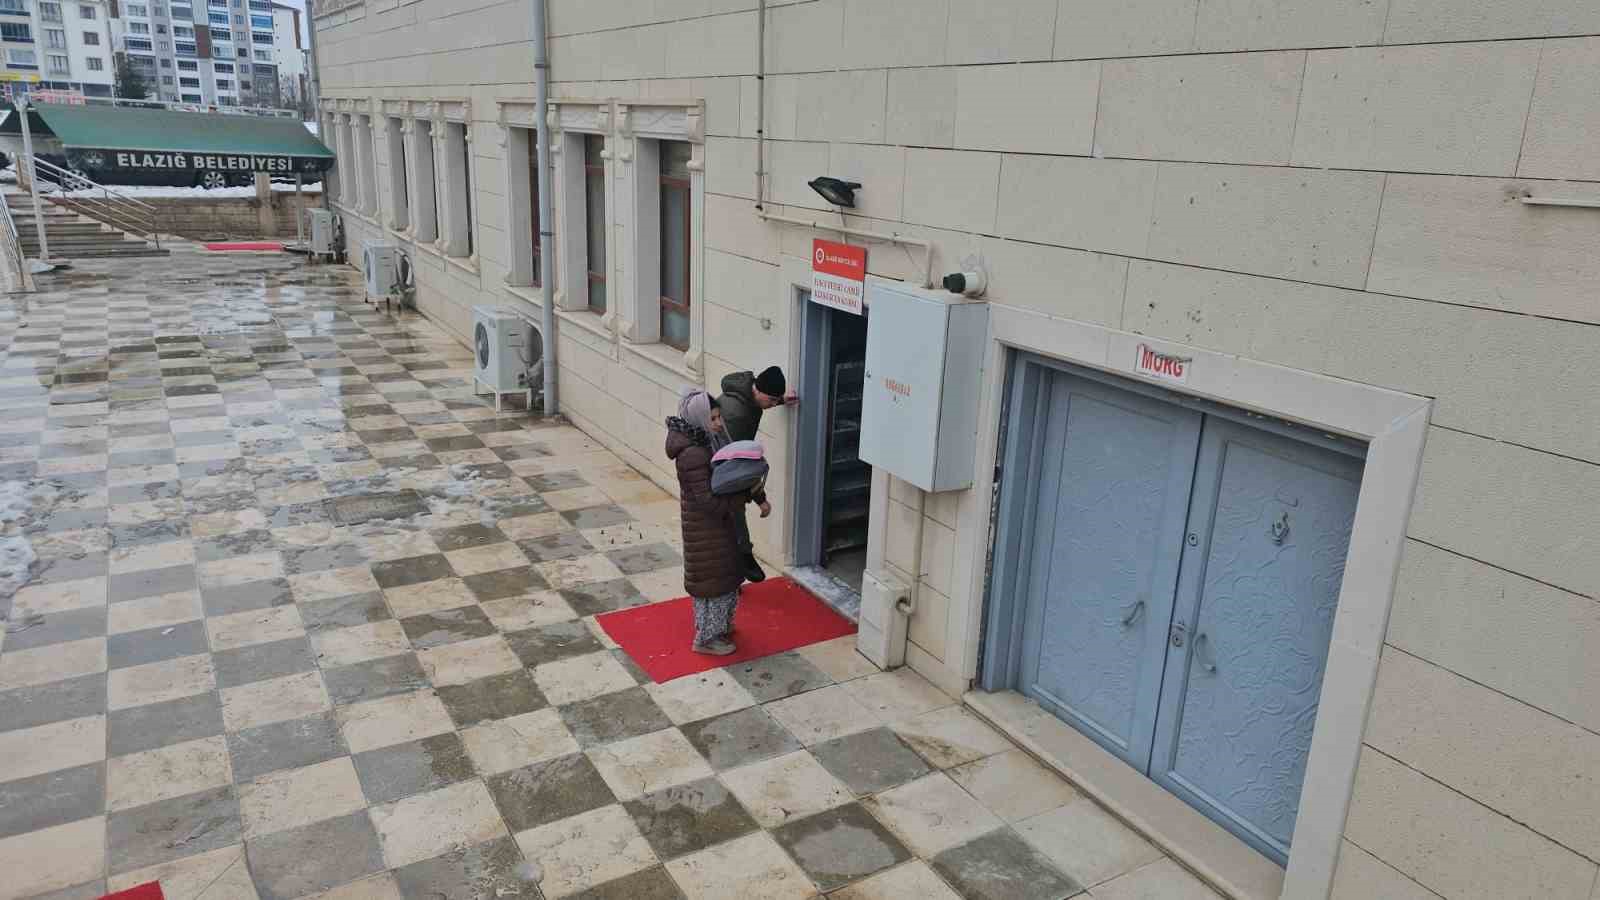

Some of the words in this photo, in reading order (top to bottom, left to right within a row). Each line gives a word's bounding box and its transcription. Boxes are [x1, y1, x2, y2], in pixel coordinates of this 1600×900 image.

[117, 152, 187, 168] ELAZIĞ
[193, 154, 293, 171] BELEDİYESİ
[1141, 351, 1184, 377] MORG
